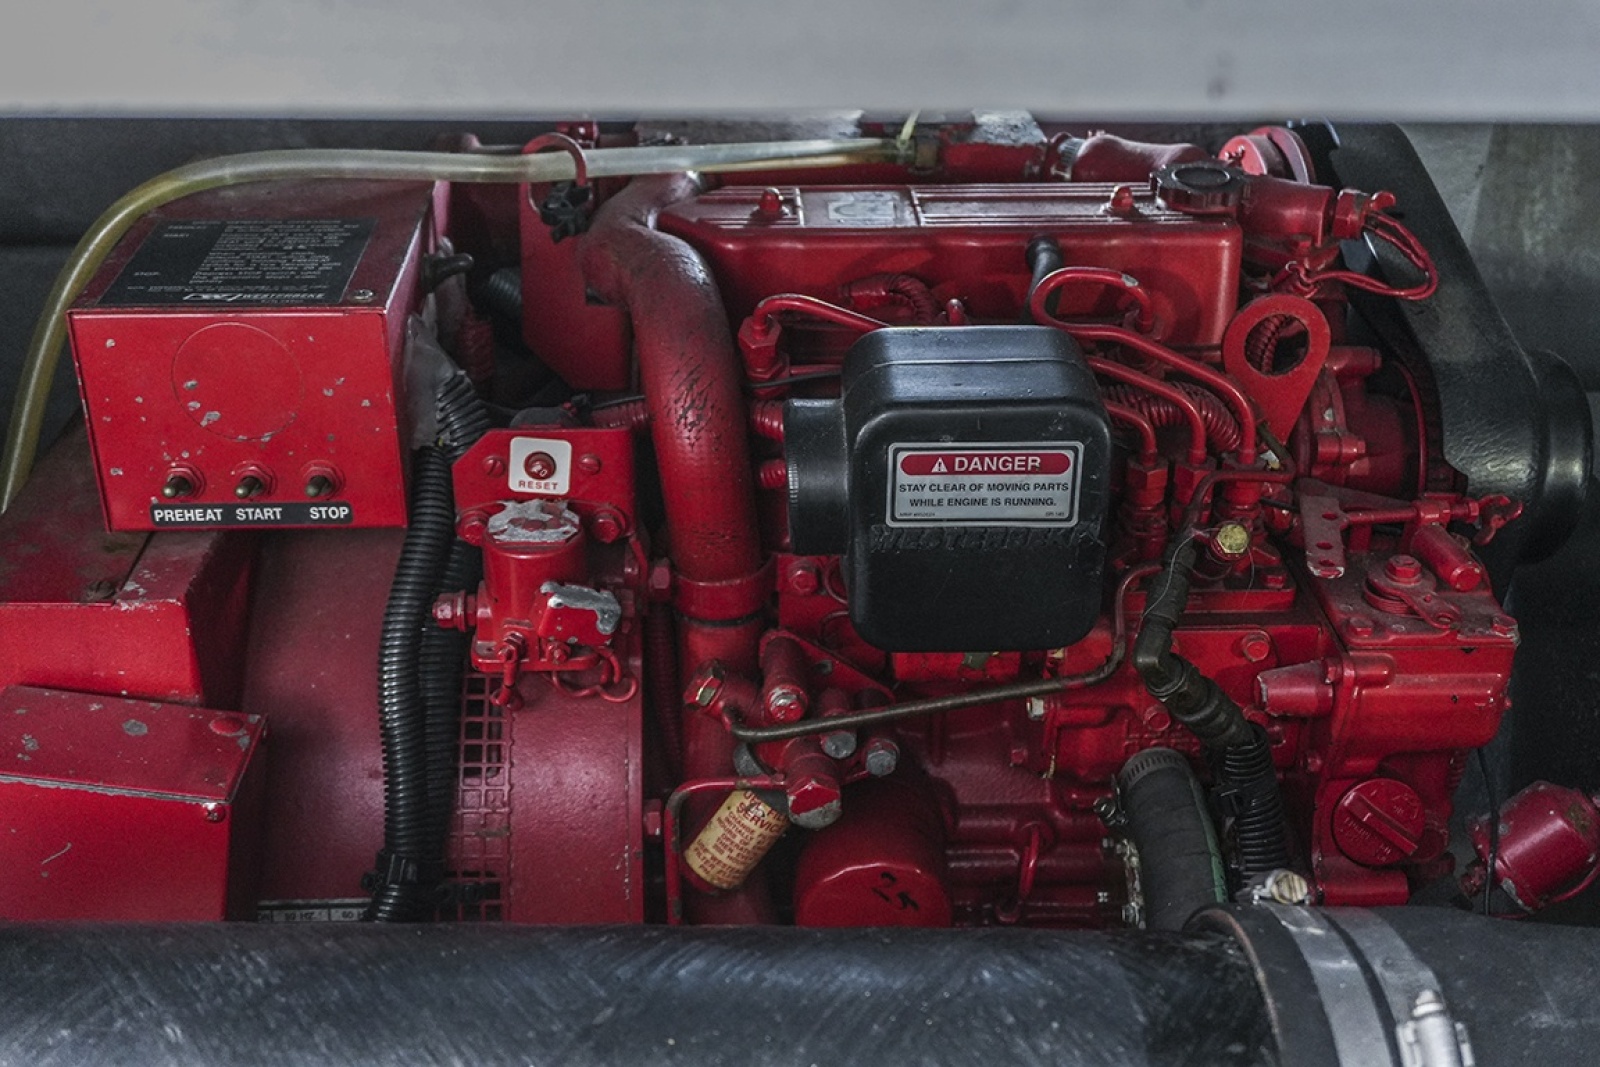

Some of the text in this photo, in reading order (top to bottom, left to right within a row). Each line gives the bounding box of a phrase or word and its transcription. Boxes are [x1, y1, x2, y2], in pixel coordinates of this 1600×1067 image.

[954, 456, 1041, 472] DANGER
[518, 480, 559, 490] RESET
[899, 482, 1069, 493] STAY CLEAR OF MOVING PARTS
[909, 497, 1057, 507] WHILE ENGINE IS RUNNING.
[153, 506, 349, 522] PREHEAT START STOP
